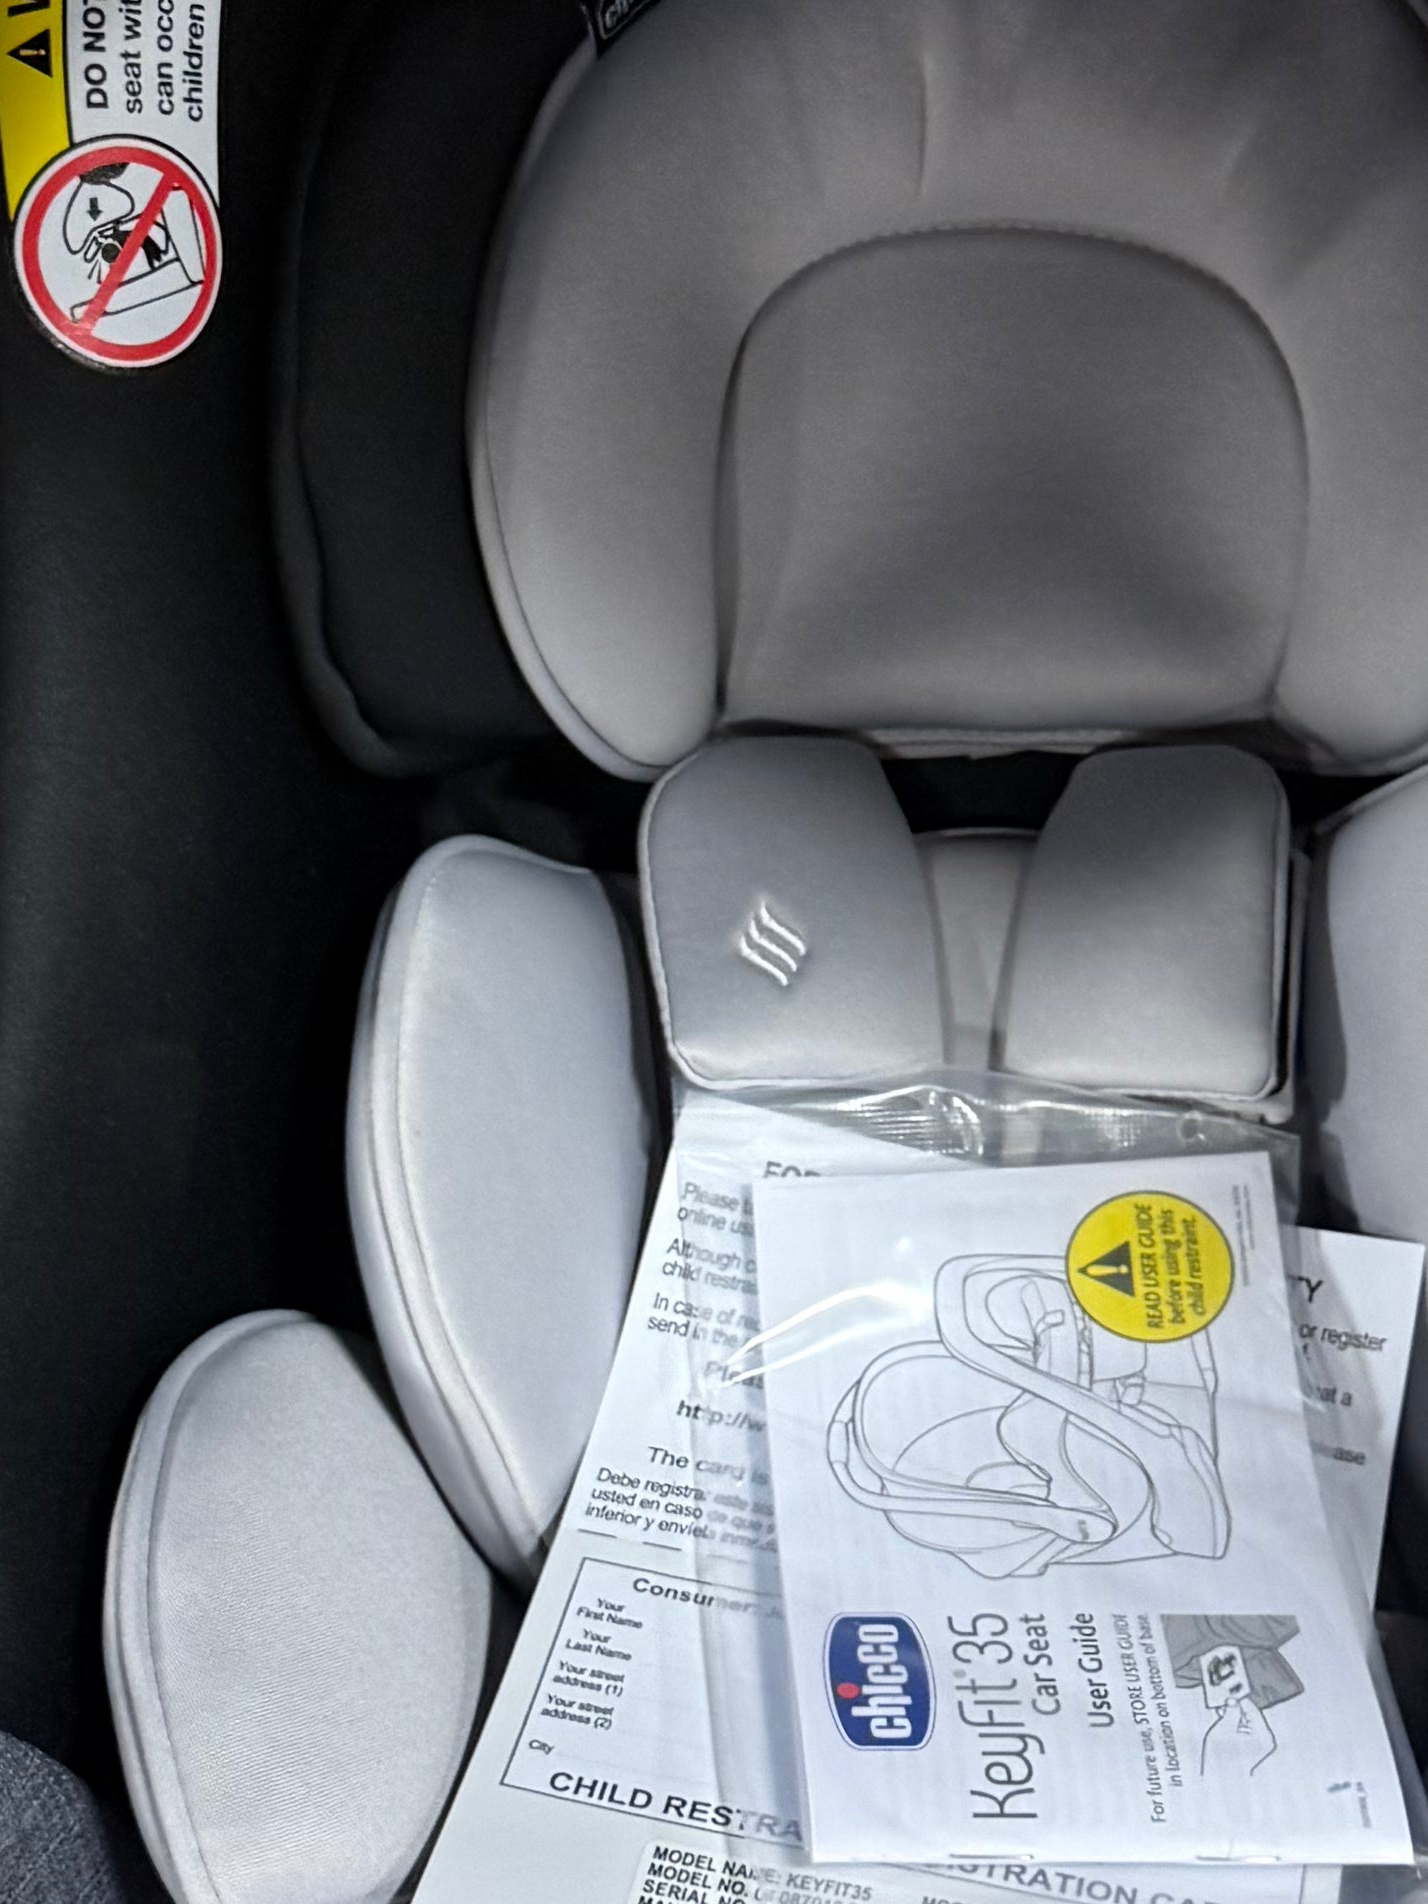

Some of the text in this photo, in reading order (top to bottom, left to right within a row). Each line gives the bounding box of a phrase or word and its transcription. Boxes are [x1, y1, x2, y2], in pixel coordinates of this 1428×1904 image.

[182, 3, 205, 122] children
[84, 63, 109, 109] DO
[120, 53, 143, 114] seat
[158, 63, 174, 115] can
[1157, 1208, 1176, 1235] this
[667, 1237, 742, 1269] Although
[1135, 1203, 1165, 1329] READ USER GUIDE
[673, 1299, 713, 1321] case
[1167, 1279, 1186, 1324] before
[1185, 1281, 1205, 1316] child
[647, 1316, 690, 1337] send
[1321, 1327, 1387, 1352] register
[648, 1446, 689, 1469] The
[596, 1467, 641, 1489] Debe
[585, 1502, 642, 1526] inferior
[643, 1517, 655, 1531] y
[590, 1487, 637, 1507] usted
[639, 1496, 660, 1511] en
[664, 1500, 704, 1520] caso
[576, 1606, 643, 1629] First Name
[597, 1598, 625, 1612] Your
[565, 1638, 632, 1661] Last Name
[582, 1629, 612, 1643] Your
[947, 1613, 1013, 1664] 35
[1143, 1639, 1156, 1654] of
[559, 1660, 625, 1683] Your street
[1020, 1613, 1061, 1715] Car Seat
[1070, 1613, 1114, 1727] User Guide
[1121, 1652, 1140, 1682] USER
[1148, 1658, 1166, 1700] bottom
[553, 1674, 624, 1697] address (1)
[836, 1624, 913, 1738] chicco
[541, 1707, 612, 1731] address (2)
[547, 1693, 614, 1716] Your street
[1127, 1686, 1149, 1725] STORE
[1156, 1701, 1169, 1717] on
[1158, 1719, 1180, 1771] location
[1145, 1755, 1162, 1796] future
[1169, 1774, 1183, 1787] in
[549, 1771, 653, 1809] CHILD
[662, 1794, 803, 1842] RESTRA
[1151, 1800, 1166, 1823] For
[647, 1862, 711, 1889] MODEL
[717, 1878, 748, 1897] NO.
[652, 1845, 716, 1872] MODEL
[786, 1873, 874, 1900] KEYFIT35
